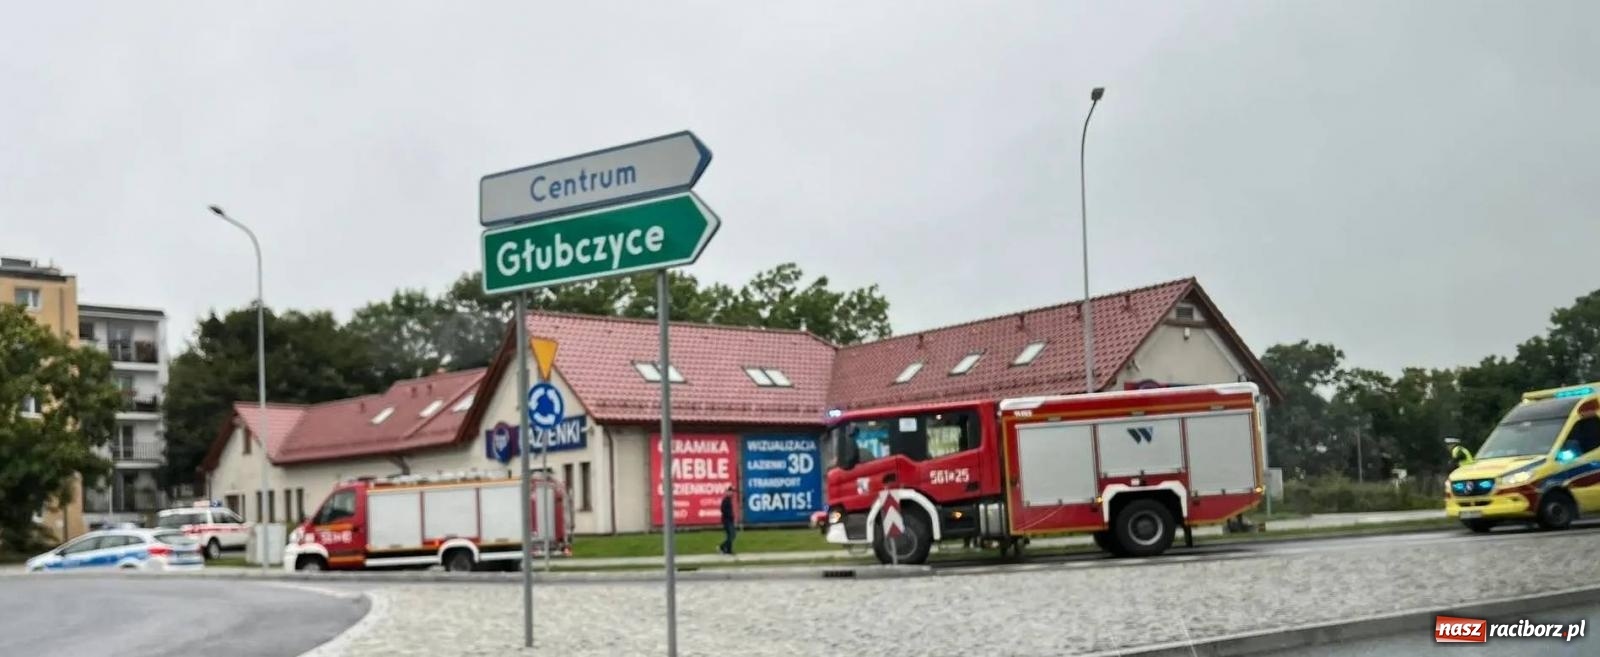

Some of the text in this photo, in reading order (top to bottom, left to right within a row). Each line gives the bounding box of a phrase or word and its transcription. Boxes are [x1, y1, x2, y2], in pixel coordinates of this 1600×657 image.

[530, 164, 637, 202] Centrum
[496, 224, 665, 276] Głubczyce
[787, 453, 814, 474] 3D
[748, 491, 812, 511] GRATIS!
